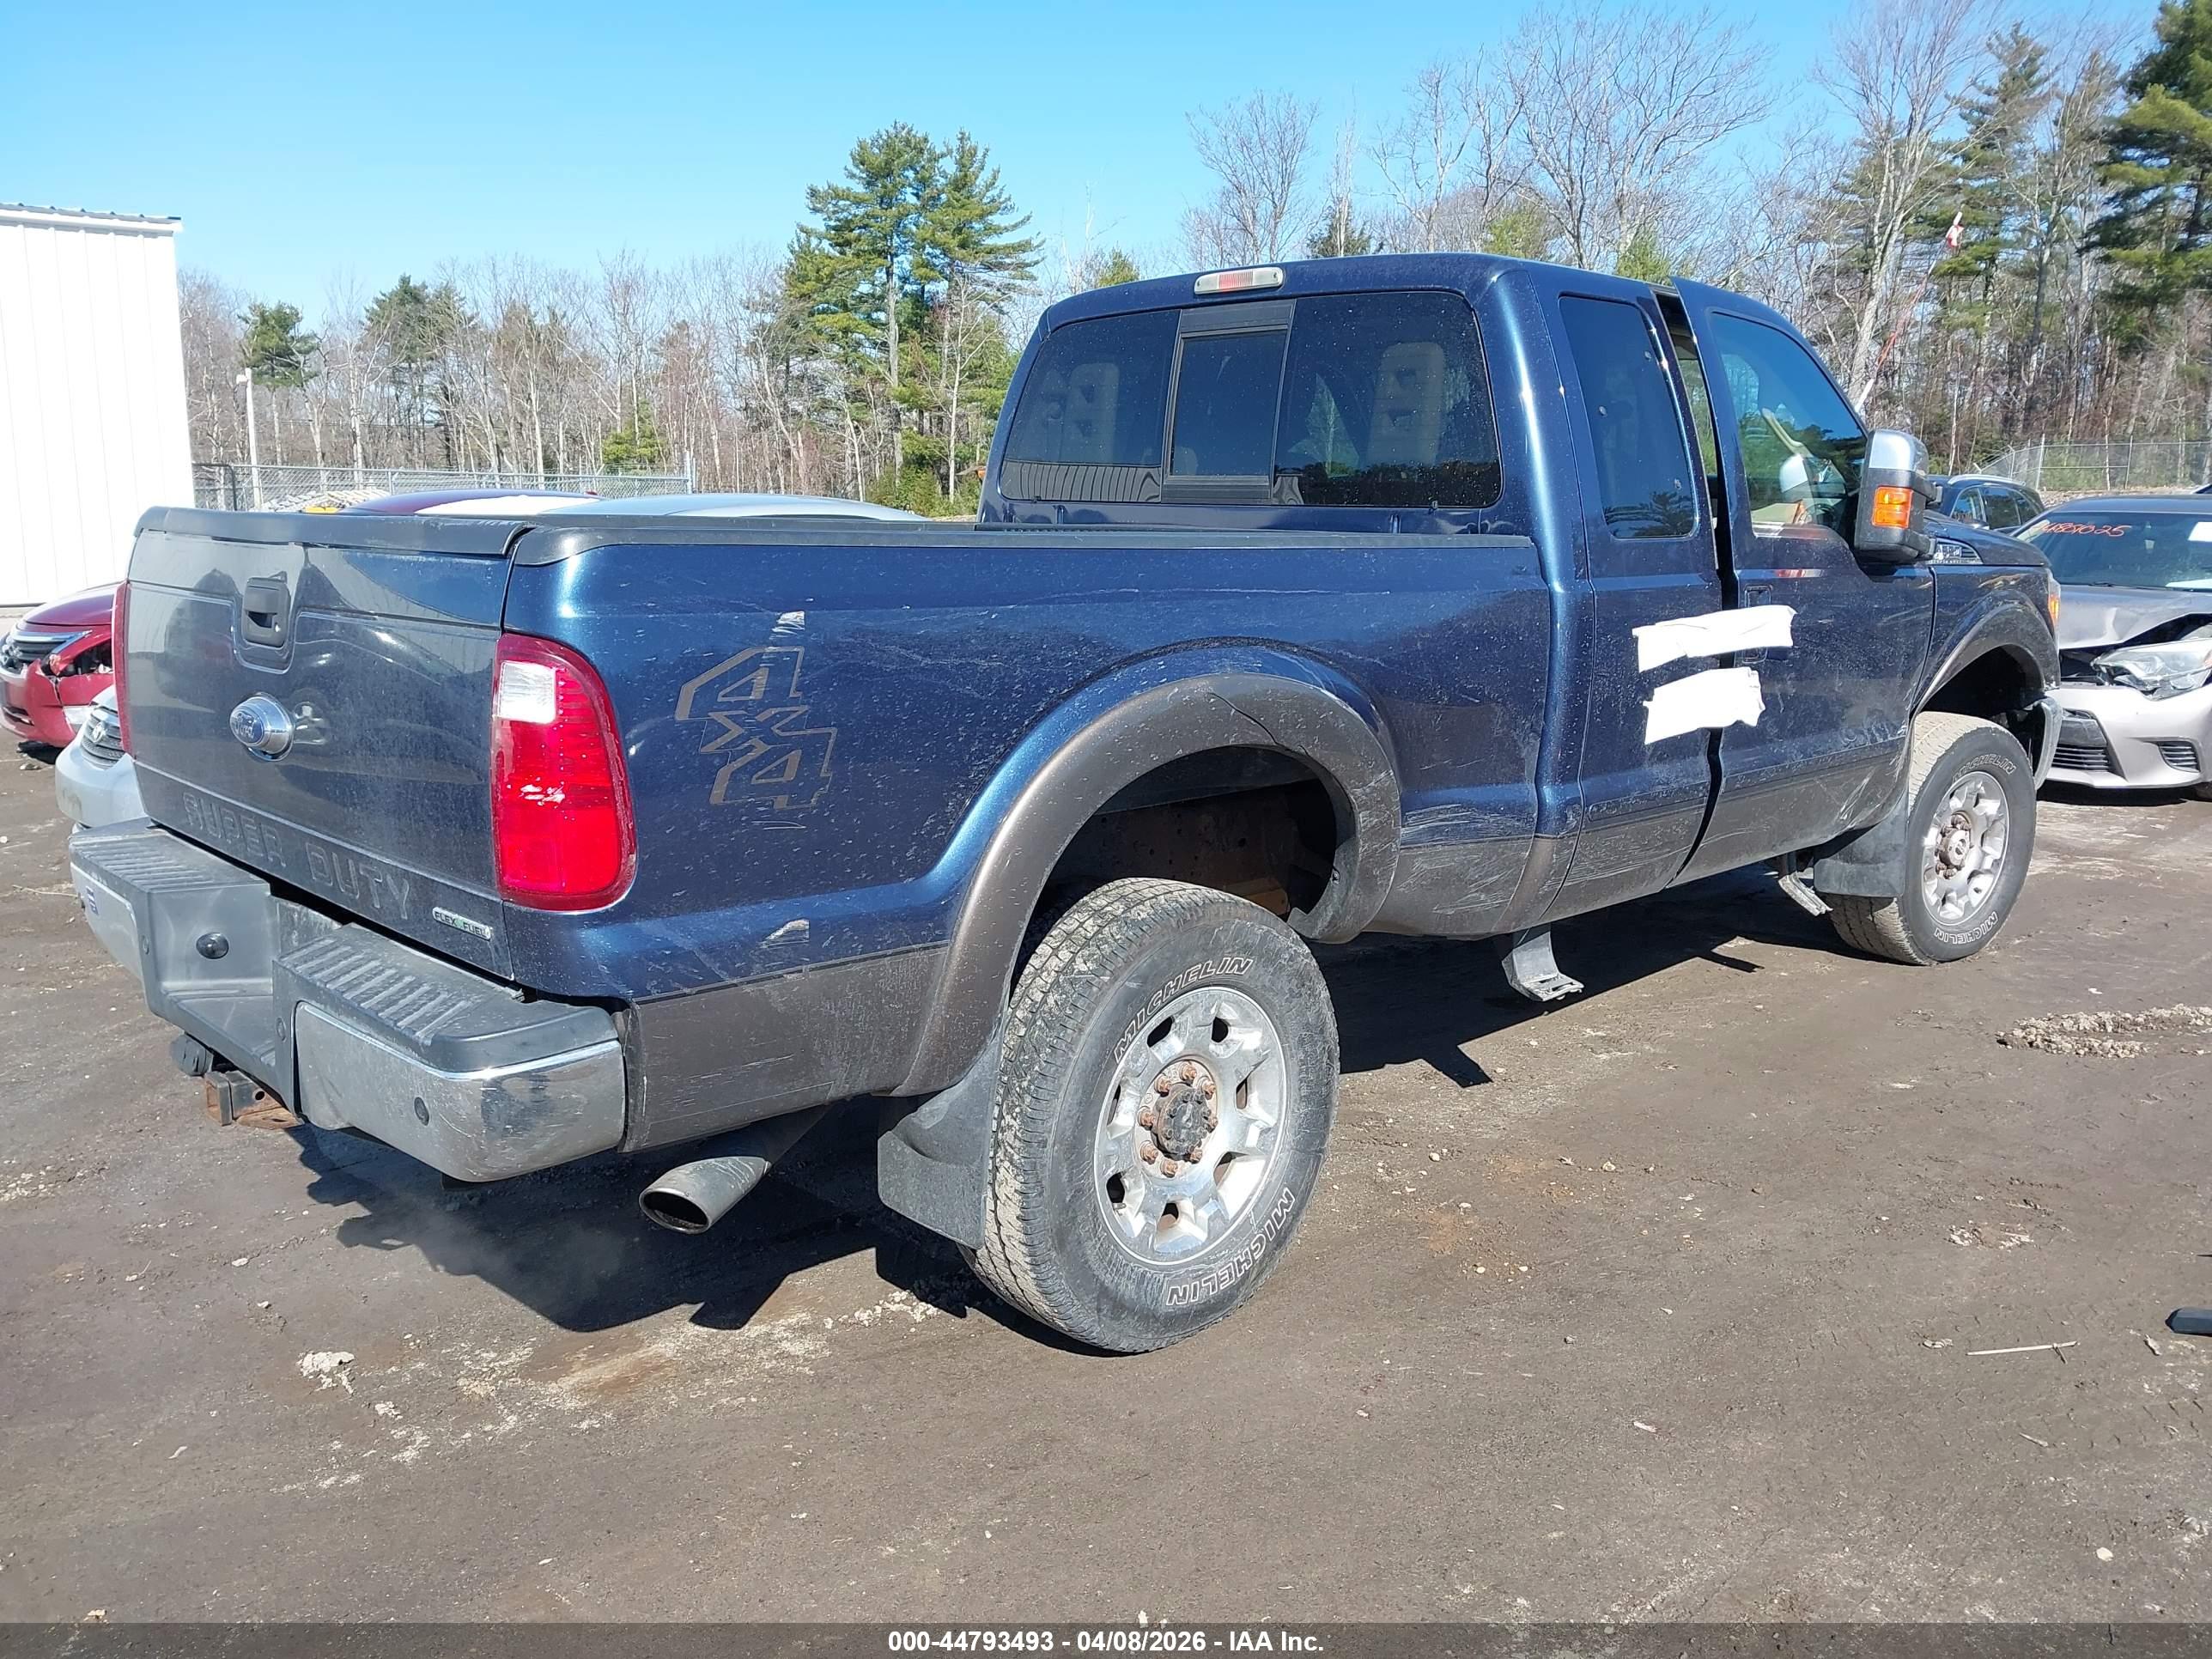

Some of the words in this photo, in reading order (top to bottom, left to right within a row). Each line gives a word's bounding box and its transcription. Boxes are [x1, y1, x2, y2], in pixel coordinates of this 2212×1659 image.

[1952, 753, 2016, 785] MICHELIN
[183, 792, 286, 867] SUPER
[305, 842, 410, 921] DUTY
[434, 911, 458, 927] FLEX
[463, 921, 488, 938] FUEL
[1934, 911, 1998, 945] MICHELIN
[1114, 957, 1254, 1064] MICHELIN
[1166, 1187, 1295, 1306] MICHELIN
